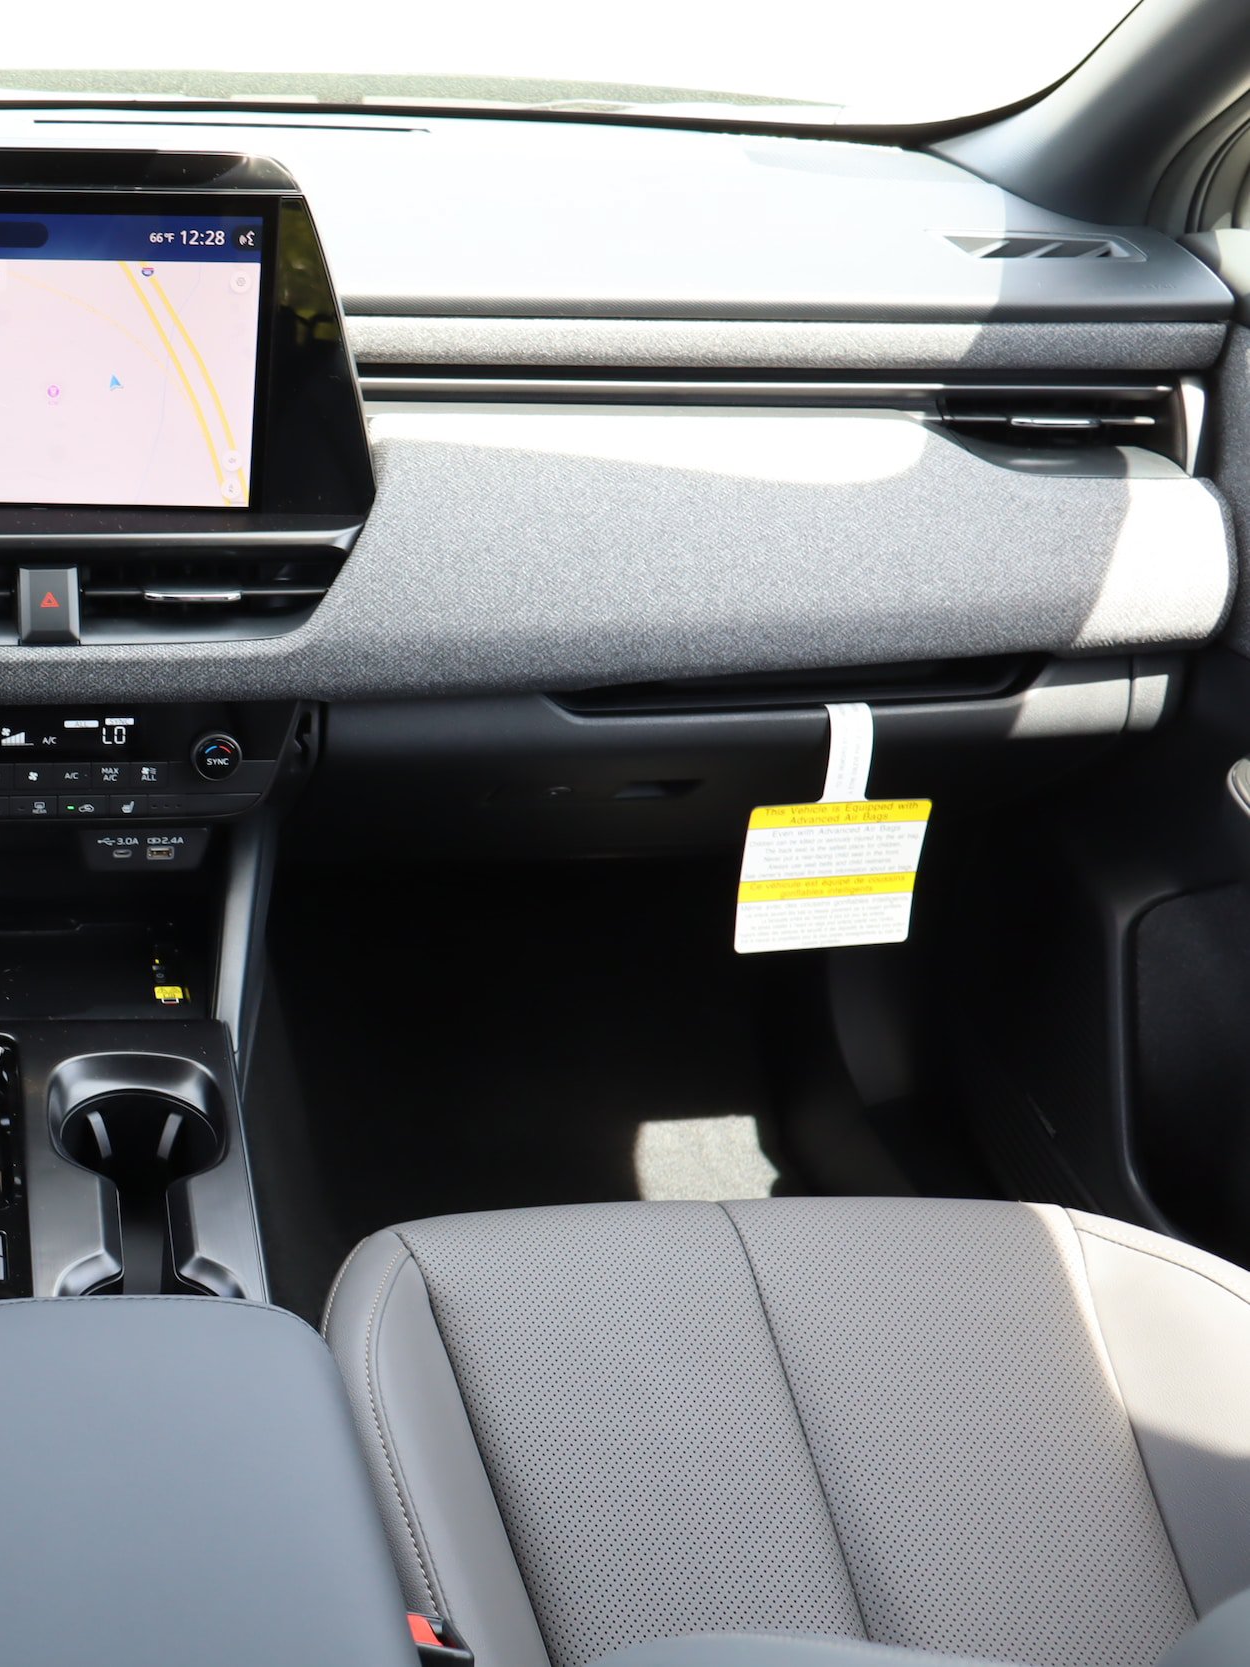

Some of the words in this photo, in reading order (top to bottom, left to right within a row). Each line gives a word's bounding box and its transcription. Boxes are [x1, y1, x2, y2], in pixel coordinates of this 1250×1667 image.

[149, 232, 175, 244] 66°F
[180, 230, 226, 246] 12:28
[102, 726, 126, 745] LO
[42, 736, 58, 745] A/C
[206, 757, 230, 766] SYNC
[101, 767, 119, 775] MAX
[64, 772, 79, 780] A/C
[103, 774, 118, 782] A/C
[141, 774, 157, 782] ALL
[765, 808, 786, 816] This
[791, 805, 828, 815] Vehicle
[832, 805, 840, 813] is
[845, 802, 894, 813] Equipped
[898, 801, 919, 810] with
[790, 814, 840, 824] Advanced
[844, 813, 859, 821] Air
[863, 812, 888, 823] Bags
[818, 825, 861, 835] Advanced
[116, 837, 139, 845] 3.0A
[161, 836, 184, 845] 2.4A
